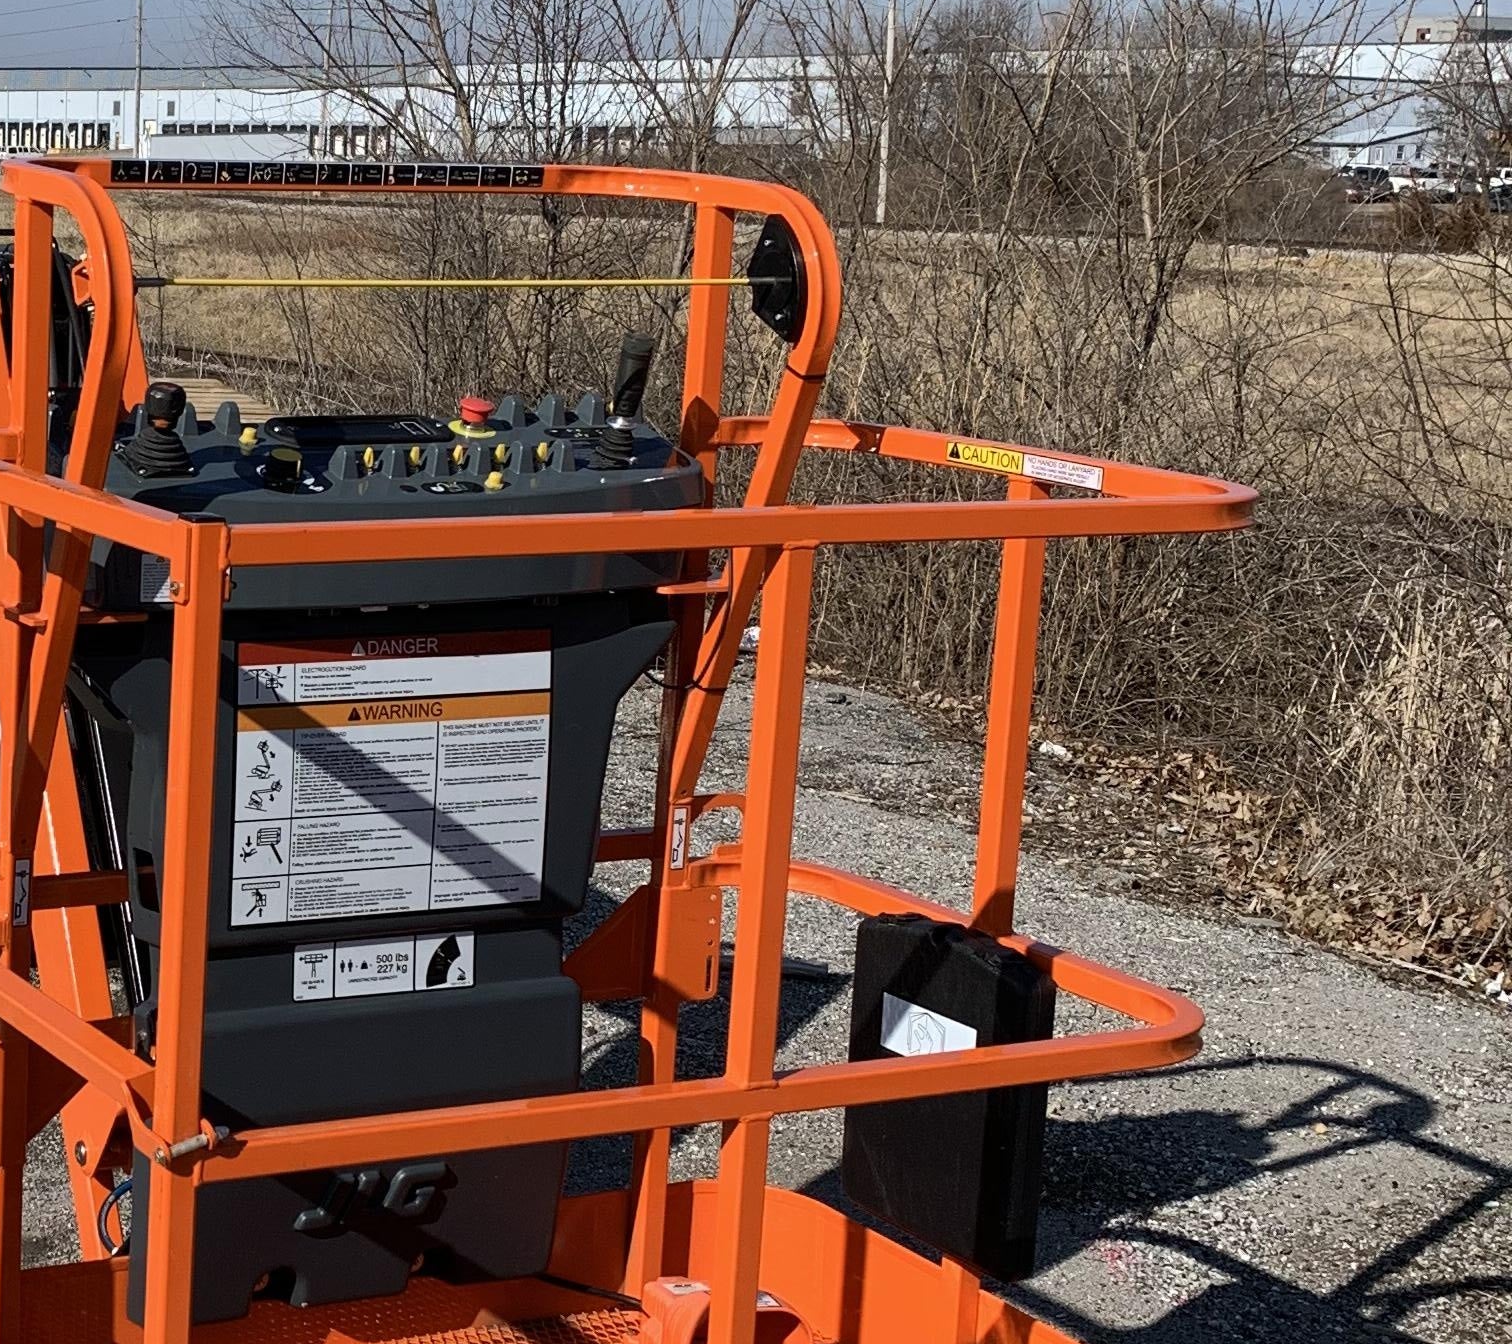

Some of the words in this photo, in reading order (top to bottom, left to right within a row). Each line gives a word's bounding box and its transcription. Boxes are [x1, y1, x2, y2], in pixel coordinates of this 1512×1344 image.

[962, 446, 1019, 470] CAUTION
[367, 637, 439, 656] DANGER
[362, 701, 443, 720] WARNING
[376, 954, 392, 964] 500
[395, 952, 409, 962] lbs
[376, 964, 393, 974] 227
[397, 963, 408, 974] kg
